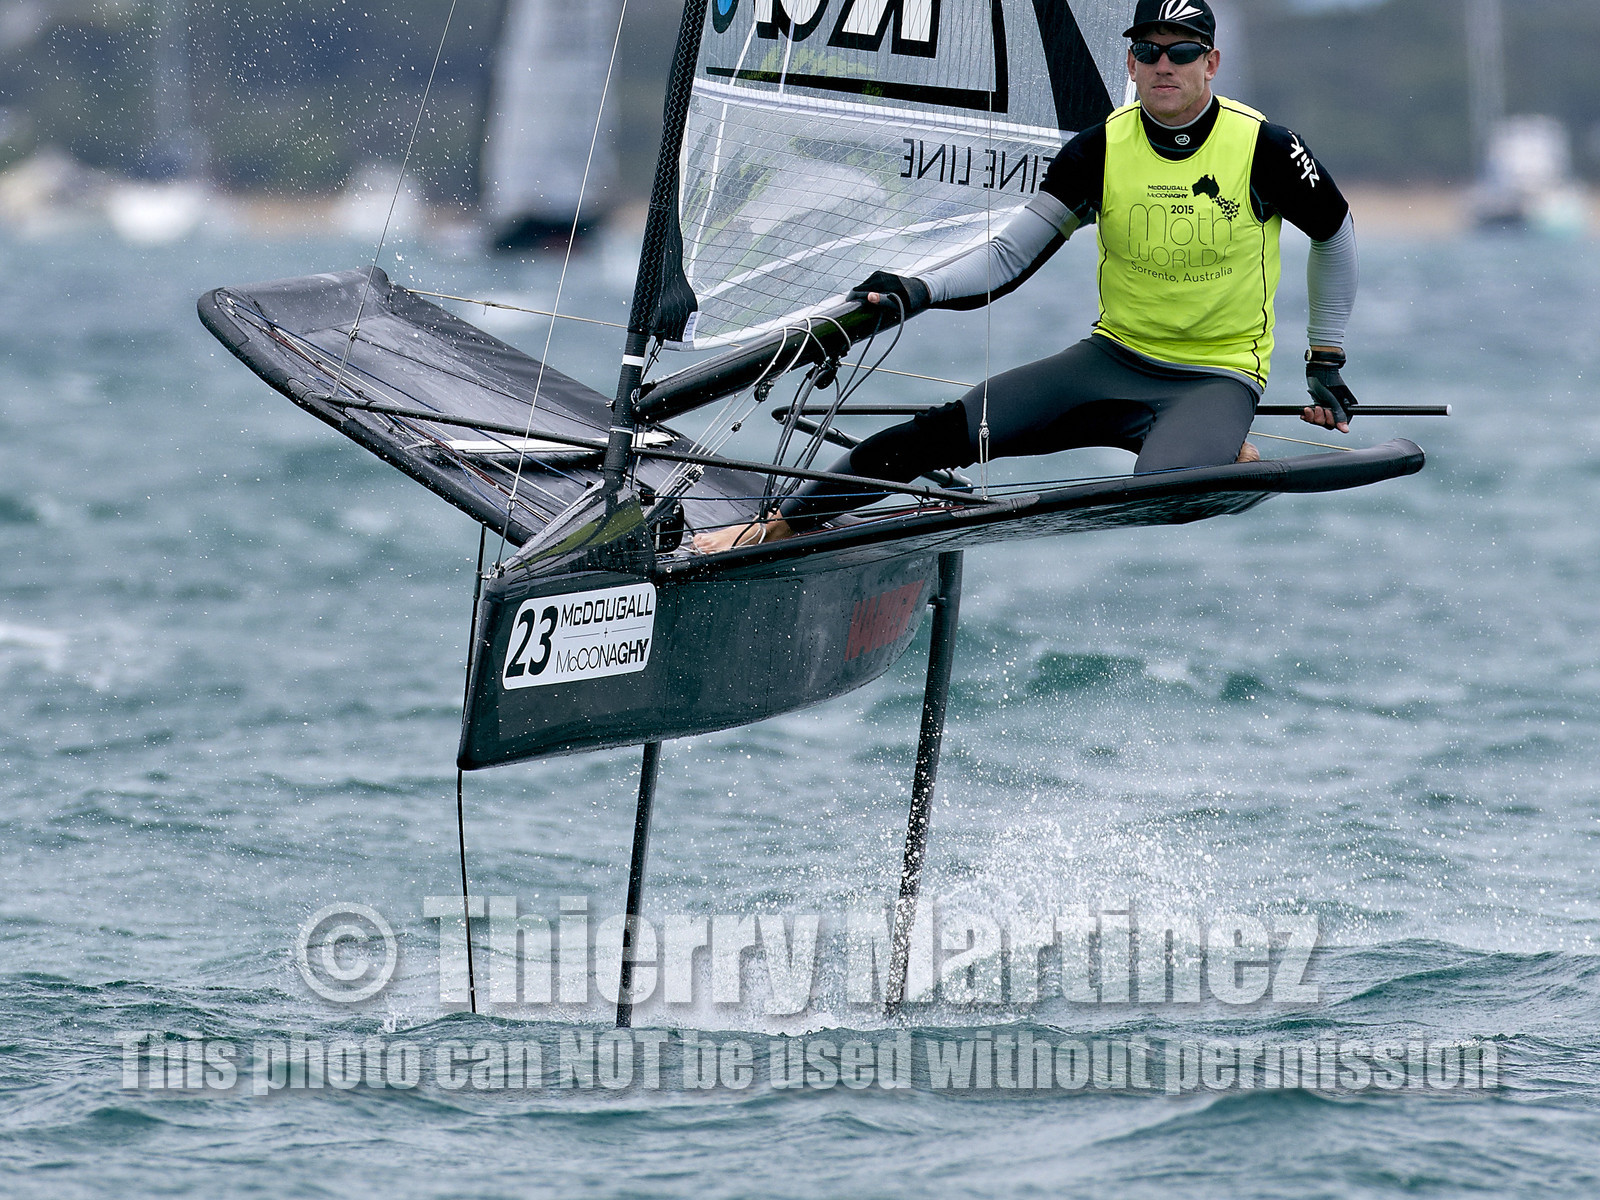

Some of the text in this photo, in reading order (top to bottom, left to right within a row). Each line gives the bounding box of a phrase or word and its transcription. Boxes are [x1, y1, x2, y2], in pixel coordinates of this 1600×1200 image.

[1170, 204, 1195, 215] 2015
[1127, 239, 1231, 269] WORLDS
[1130, 260, 1234, 283] Sorrento, Australia
[561, 593, 653, 627] McDOUGALL
[505, 605, 558, 678] 23
[556, 638, 650, 674] McCONAGHY
